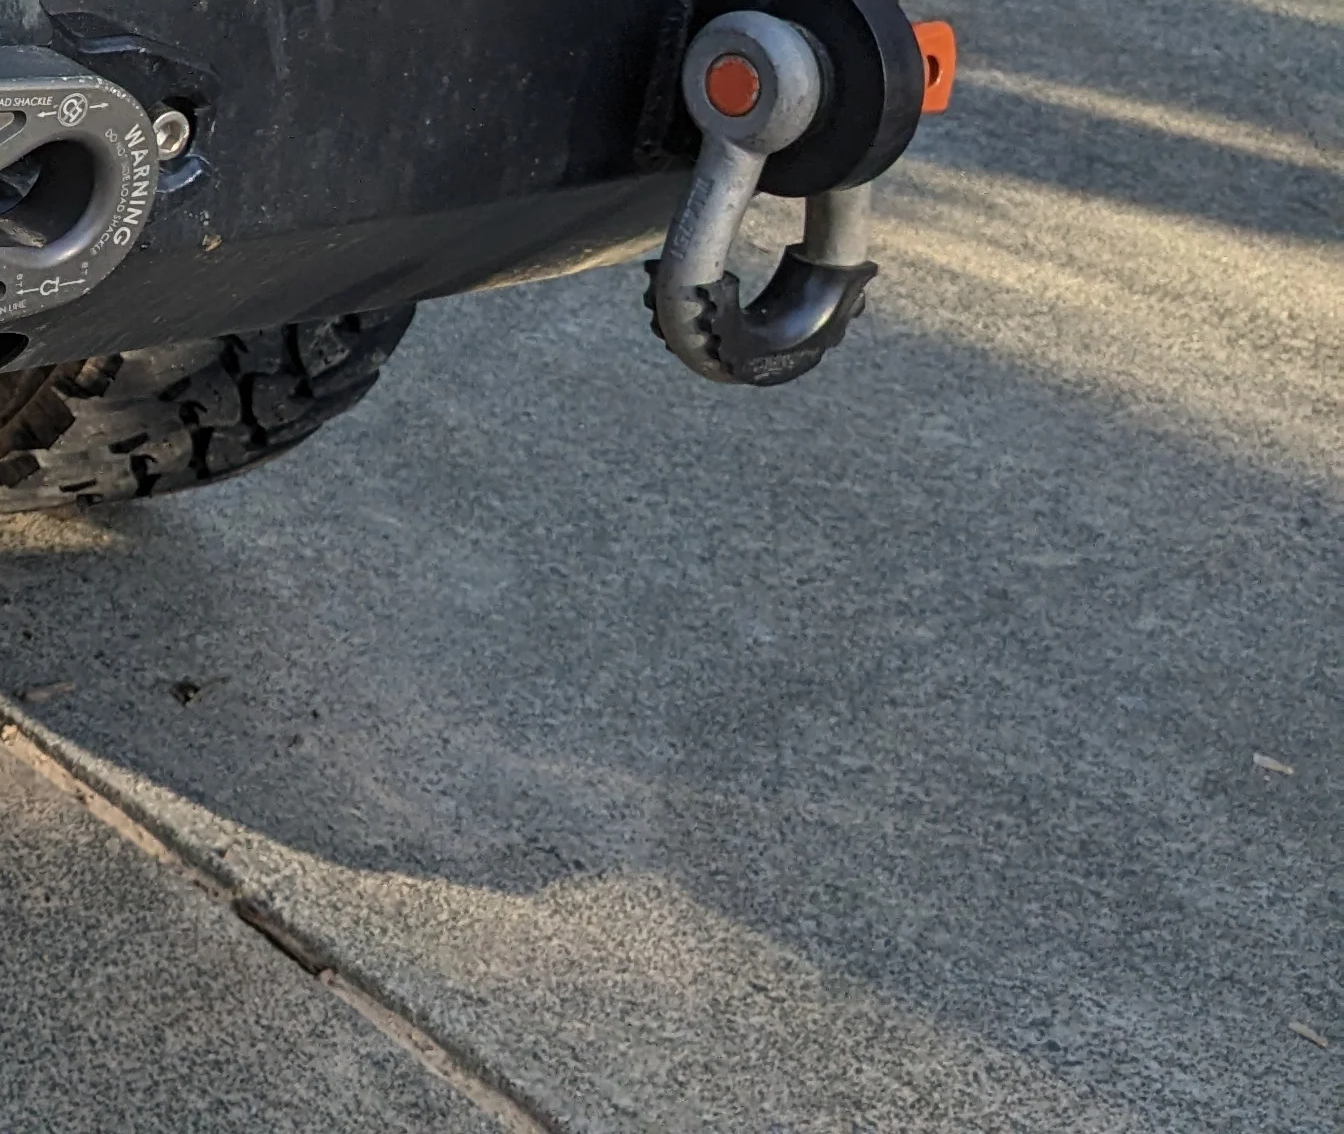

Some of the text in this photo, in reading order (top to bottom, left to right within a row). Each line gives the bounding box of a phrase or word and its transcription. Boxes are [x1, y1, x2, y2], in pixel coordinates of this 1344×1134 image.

[13, 96, 54, 107] SHACKLE
[113, 123, 150, 246] WARNING
[8, 299, 27, 312] LINE
